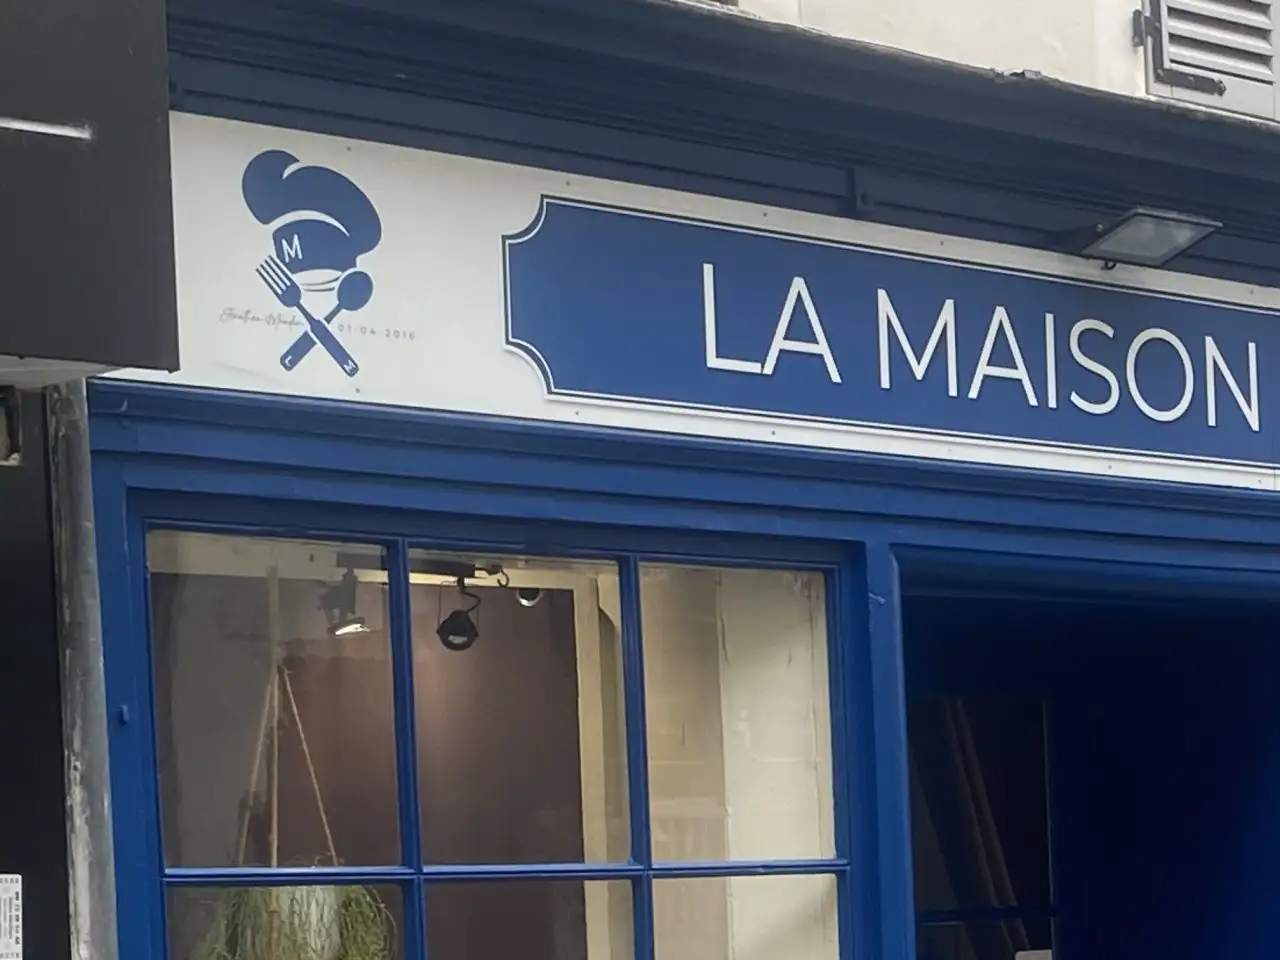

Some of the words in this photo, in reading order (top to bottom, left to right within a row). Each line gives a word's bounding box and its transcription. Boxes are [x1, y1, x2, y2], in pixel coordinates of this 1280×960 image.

[281, 233, 303, 264] M
[703, 263, 842, 383] LA
[876, 288, 1260, 432] MAISON
